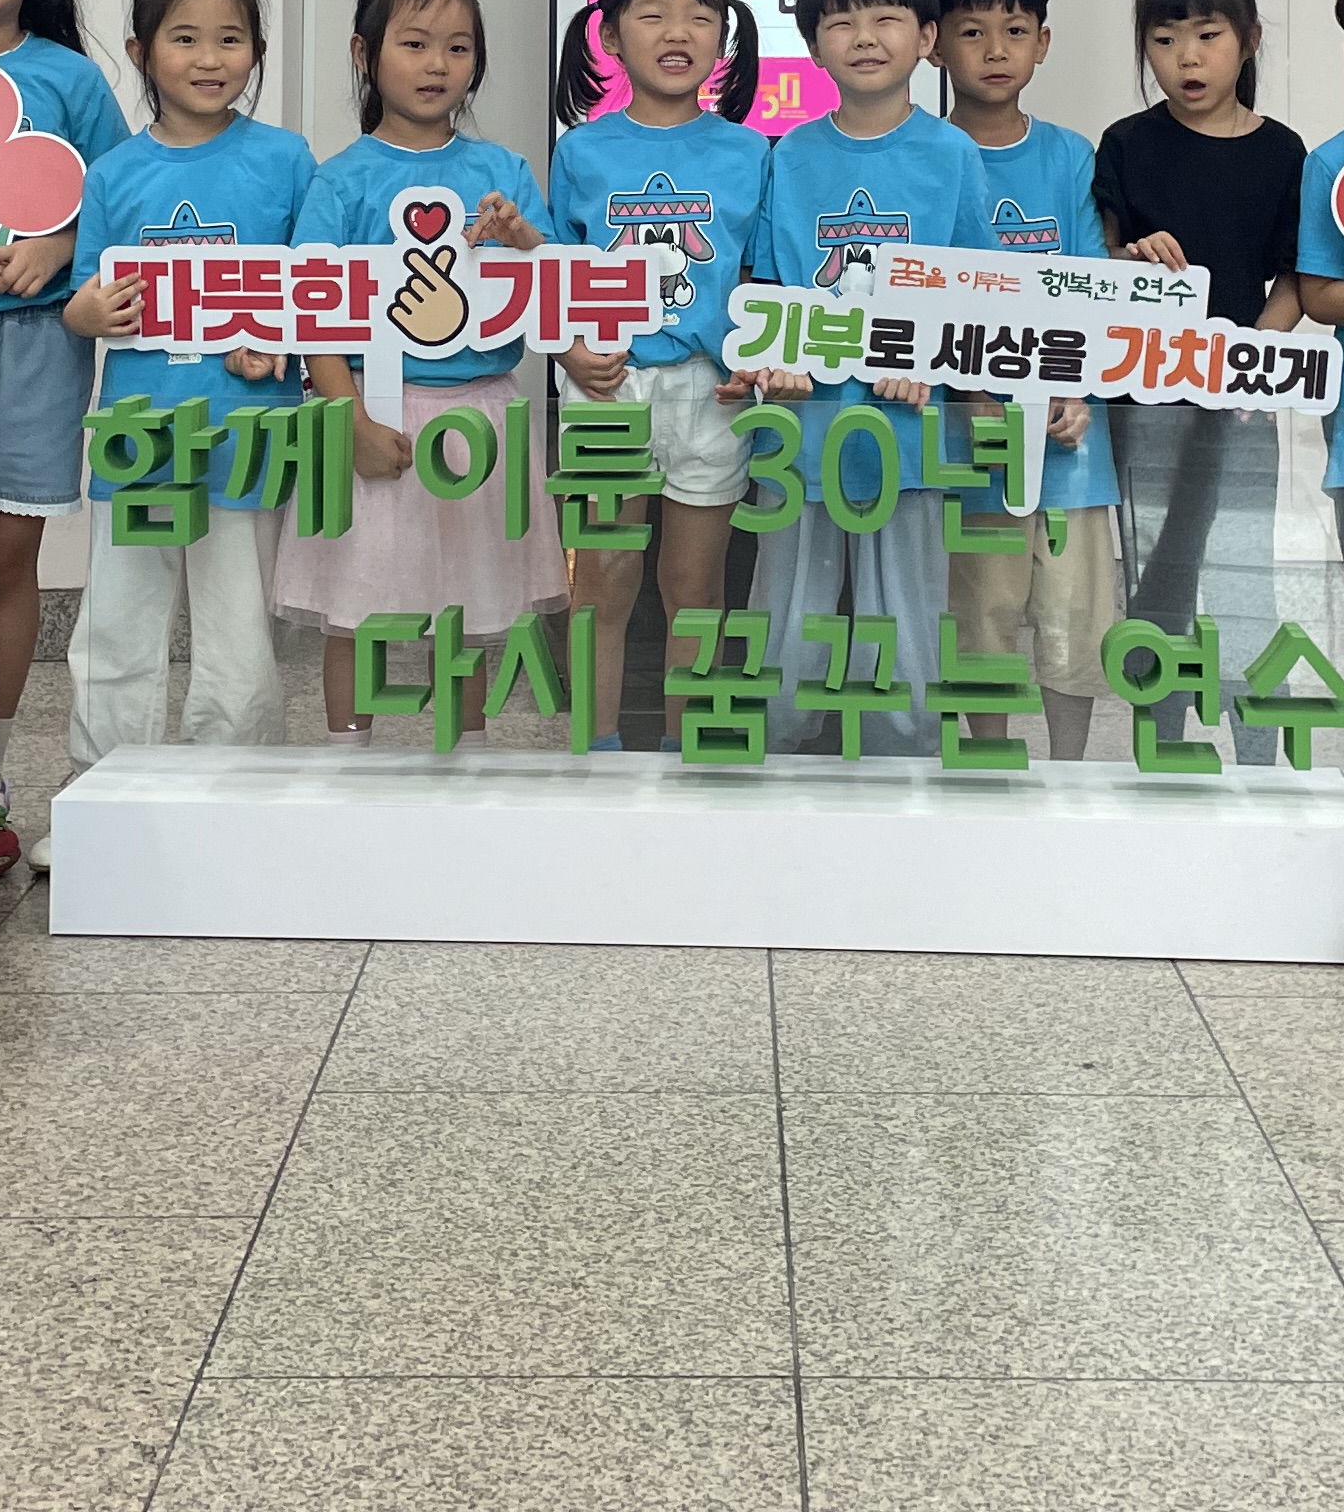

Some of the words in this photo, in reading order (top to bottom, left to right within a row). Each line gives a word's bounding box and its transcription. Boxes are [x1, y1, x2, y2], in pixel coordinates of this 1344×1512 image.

[758, 73, 800, 120] 30
[114, 258, 378, 343] 따뜻한
[480, 258, 649, 343] 기부
[890, 257, 947, 289] 꿈을
[958, 269, 1021, 294] 이루는
[1037, 267, 1119, 302] 행복한
[1129, 275, 1197, 307] 연수
[737, 299, 916, 371] 기부로
[930, 323, 1086, 383] 세상을
[1100, 326, 1328, 399] 가치있게
[83, 395, 353, 546] 함께
[413, 396, 667, 550] 이룬
[729, 402, 1068, 556] 30년,
[352, 603, 597, 756] 다시
[663, 608, 1044, 771] 꿈꾸는
